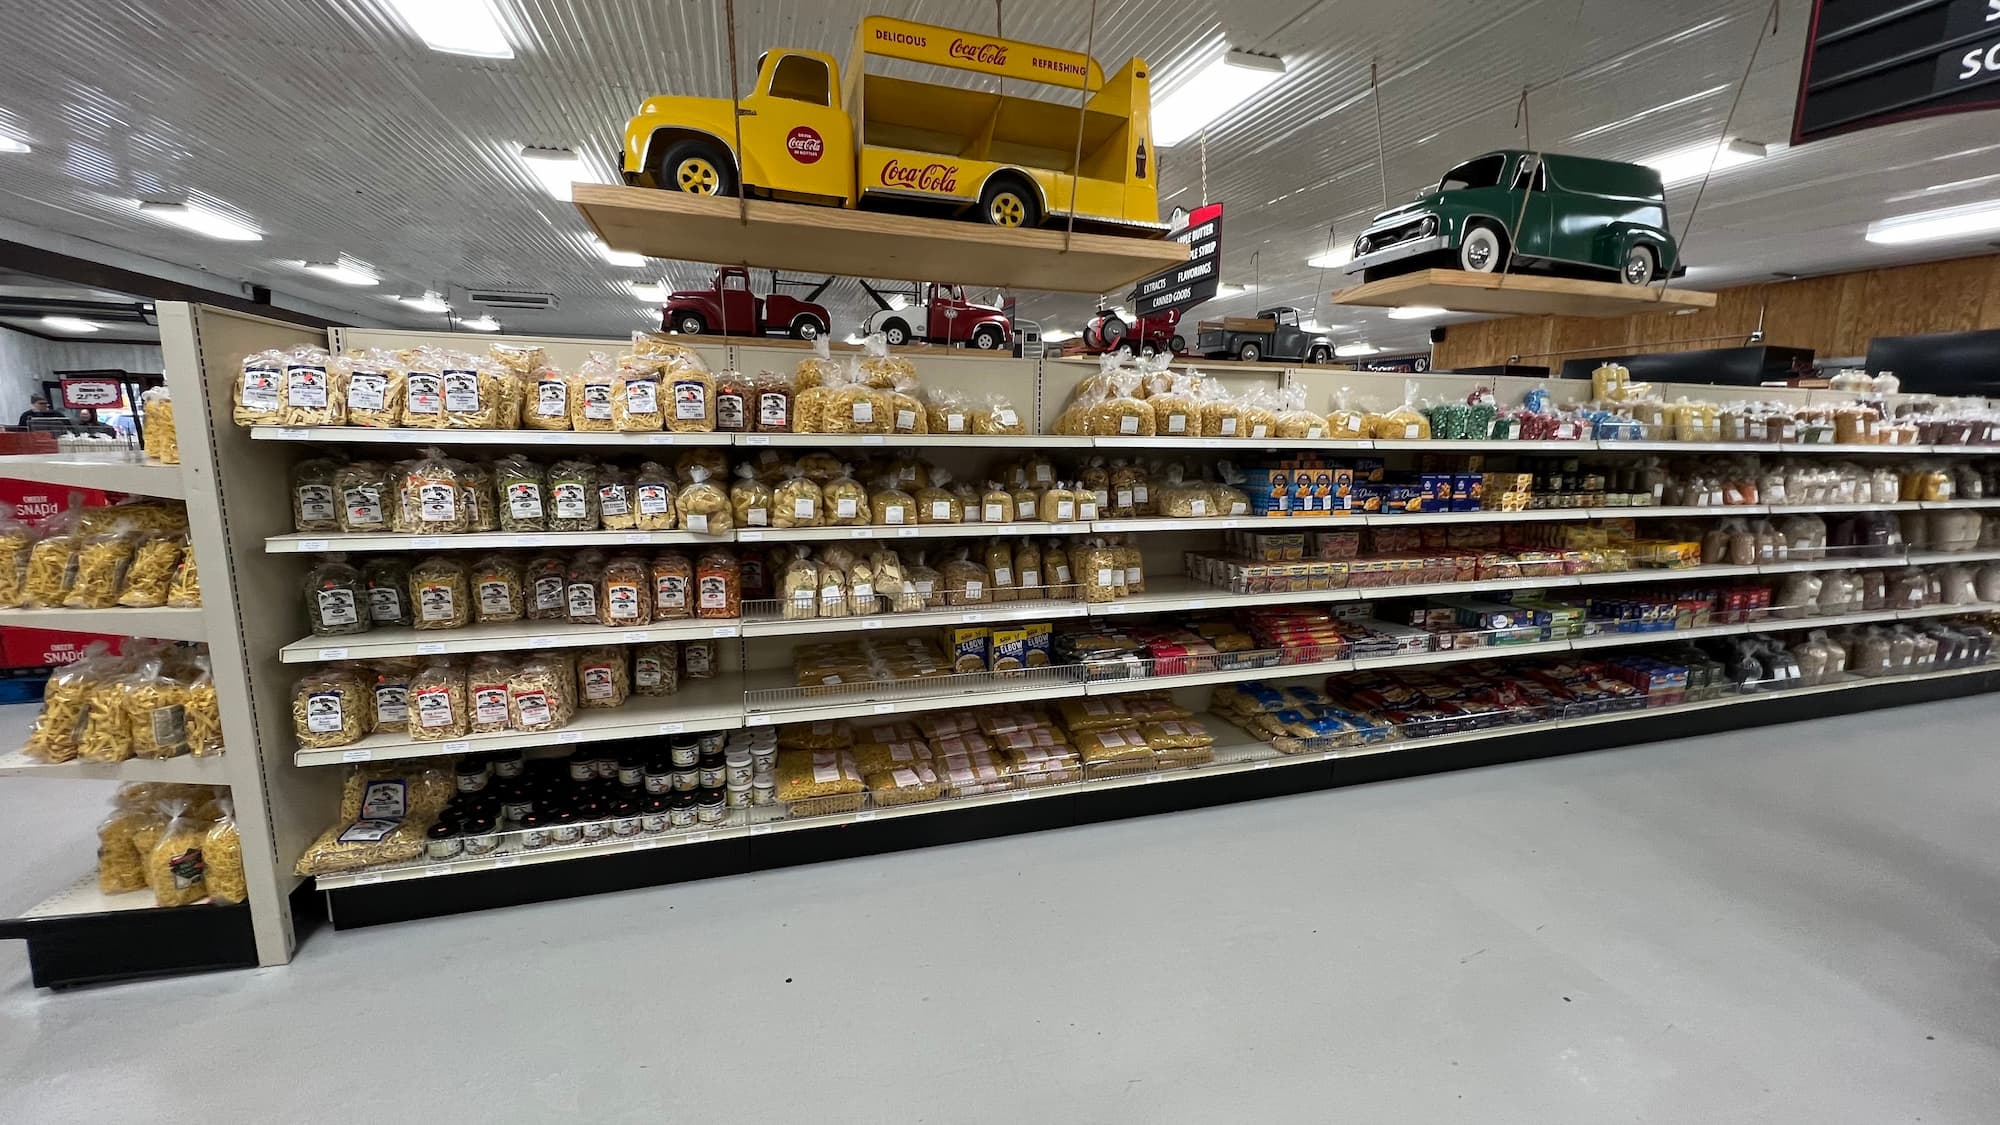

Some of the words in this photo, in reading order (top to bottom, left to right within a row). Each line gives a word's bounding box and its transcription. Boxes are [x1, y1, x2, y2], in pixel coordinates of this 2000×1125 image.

[876, 29, 927, 47] DELICIOUS
[949, 38, 1008, 66] Coca-Cola
[1032, 58, 1087, 76] REFRESHING
[788, 137, 821, 151] Coca-Cola
[880, 159, 959, 192] Coca-Cola
[1192, 222, 1213, 241] BUTTER
[1198, 241, 1216, 257] SYRUP
[1144, 278, 1166, 294] EXTRACTS
[1177, 261, 1211, 283] FLAVORINGS
[1153, 294, 1173, 308] CANNED
[1173, 287, 1192, 302] GOODS
[1168, 310, 1174, 323] 2
[962, 638, 984, 651] ELBOW
[1000, 640, 1023, 654] ELBOW
[1028, 633, 1049, 647] ELBOW
